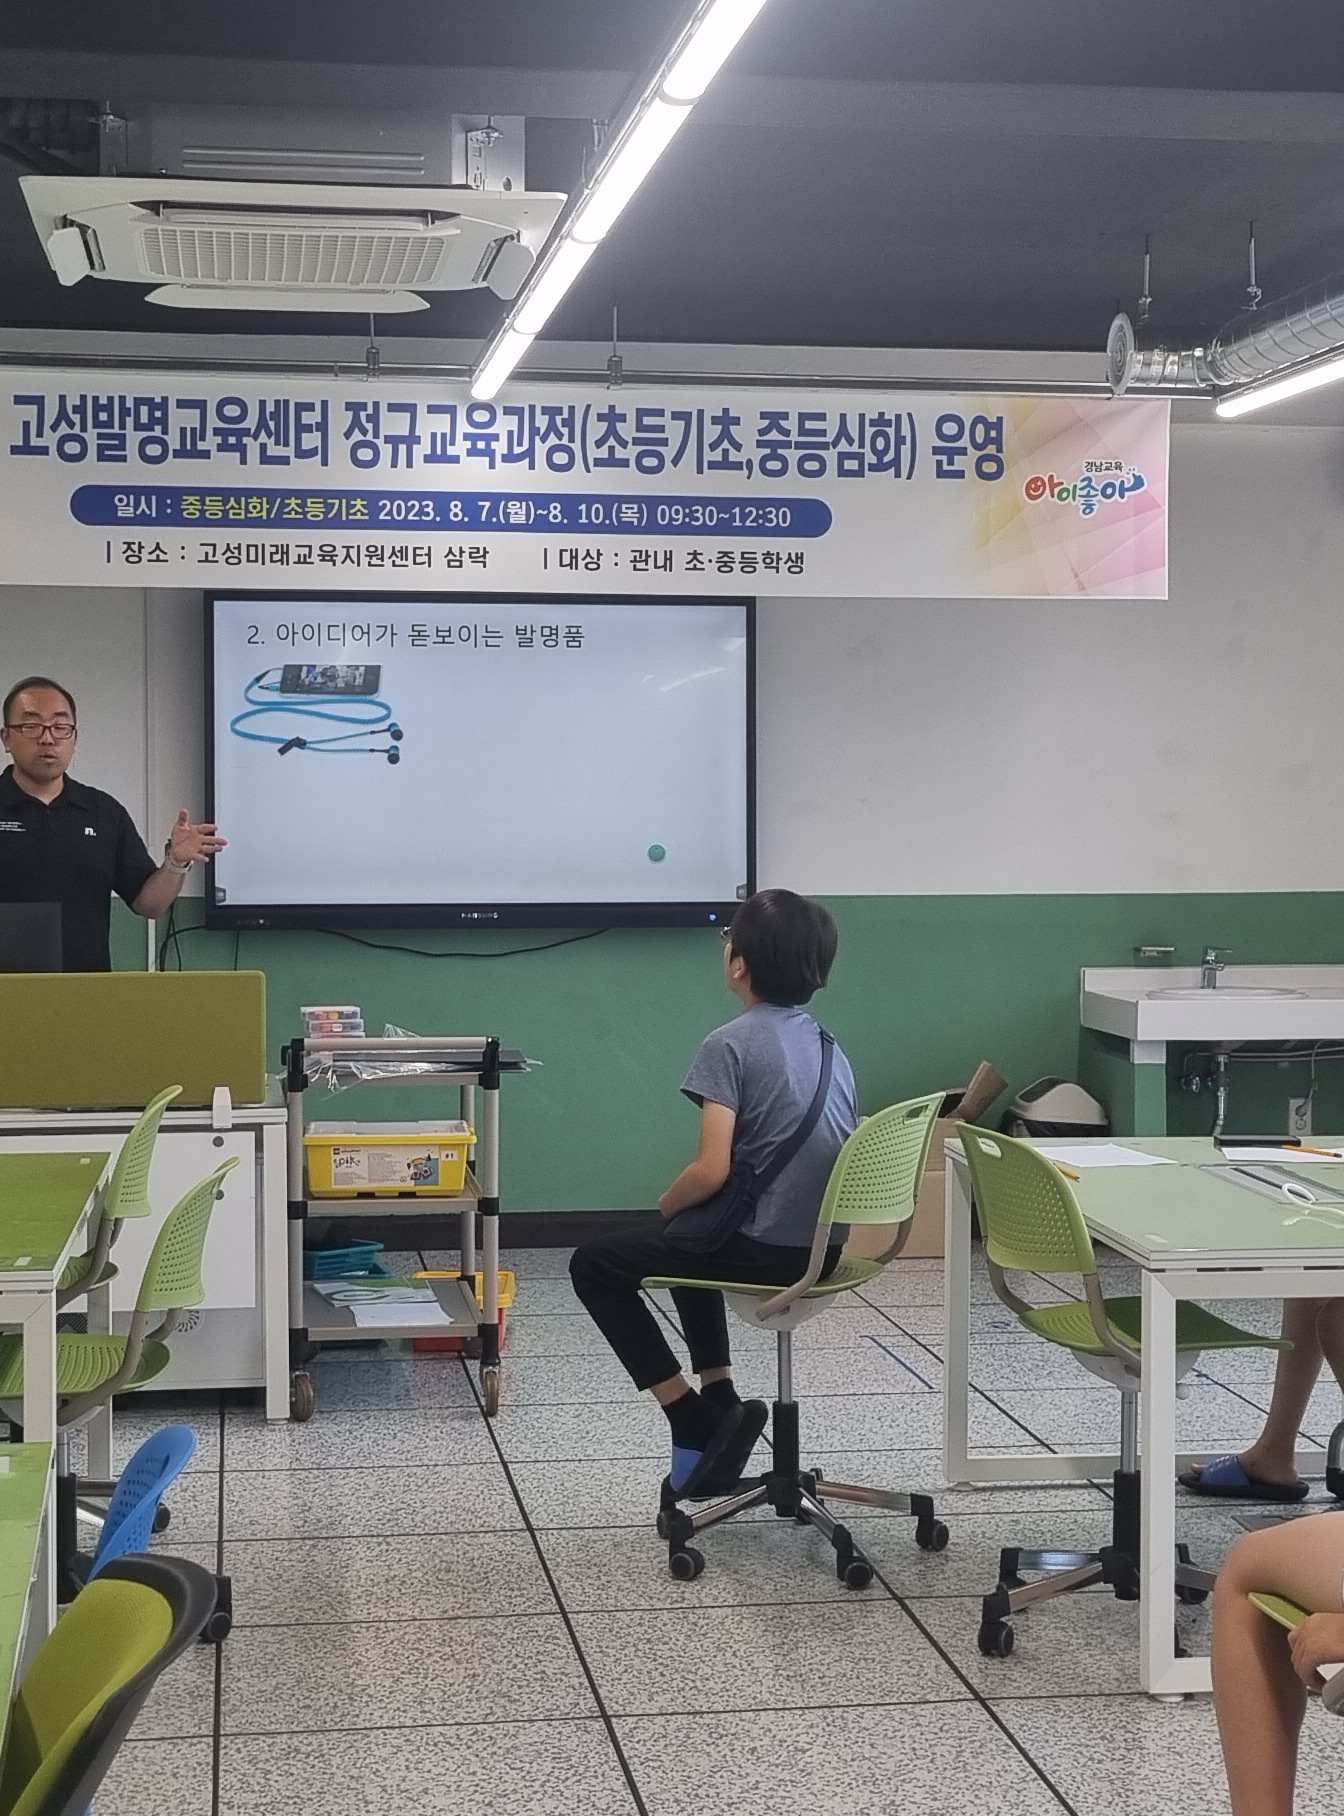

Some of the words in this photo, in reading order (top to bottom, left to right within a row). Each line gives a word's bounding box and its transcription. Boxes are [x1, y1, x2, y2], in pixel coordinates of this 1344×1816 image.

[9, 392, 330, 468] 고성발명교육센터
[342, 398, 917, 482] 정규교육과정(초등기초,중등심화)
[930, 412, 1006, 482] 운영
[1084, 461, 1123, 472] 경남교육
[1025, 473, 1145, 515] 아이좋아
[113, 493, 157, 518] 일시
[179, 494, 370, 521] 중등심화/초등기초
[378, 499, 441, 522] 2023.
[449, 500, 469, 522] 8.
[476, 500, 569, 525] 7.(월)~8.
[577, 503, 649, 527] 10.(목)
[656, 504, 792, 527] 09:30~12:30
[121, 540, 170, 565] 장소
[196, 541, 433, 569] 고성미래교육지원센터
[442, 545, 491, 569] 삼락
[558, 547, 604, 572] 대상
[628, 549, 674, 573] 관내
[683, 549, 806, 575] 초·중등학생
[246, 624, 266, 645] 2.
[275, 622, 398, 648] 아이디어가
[407, 623, 505, 649] 돋보이는
[514, 624, 586, 649] 발명품
